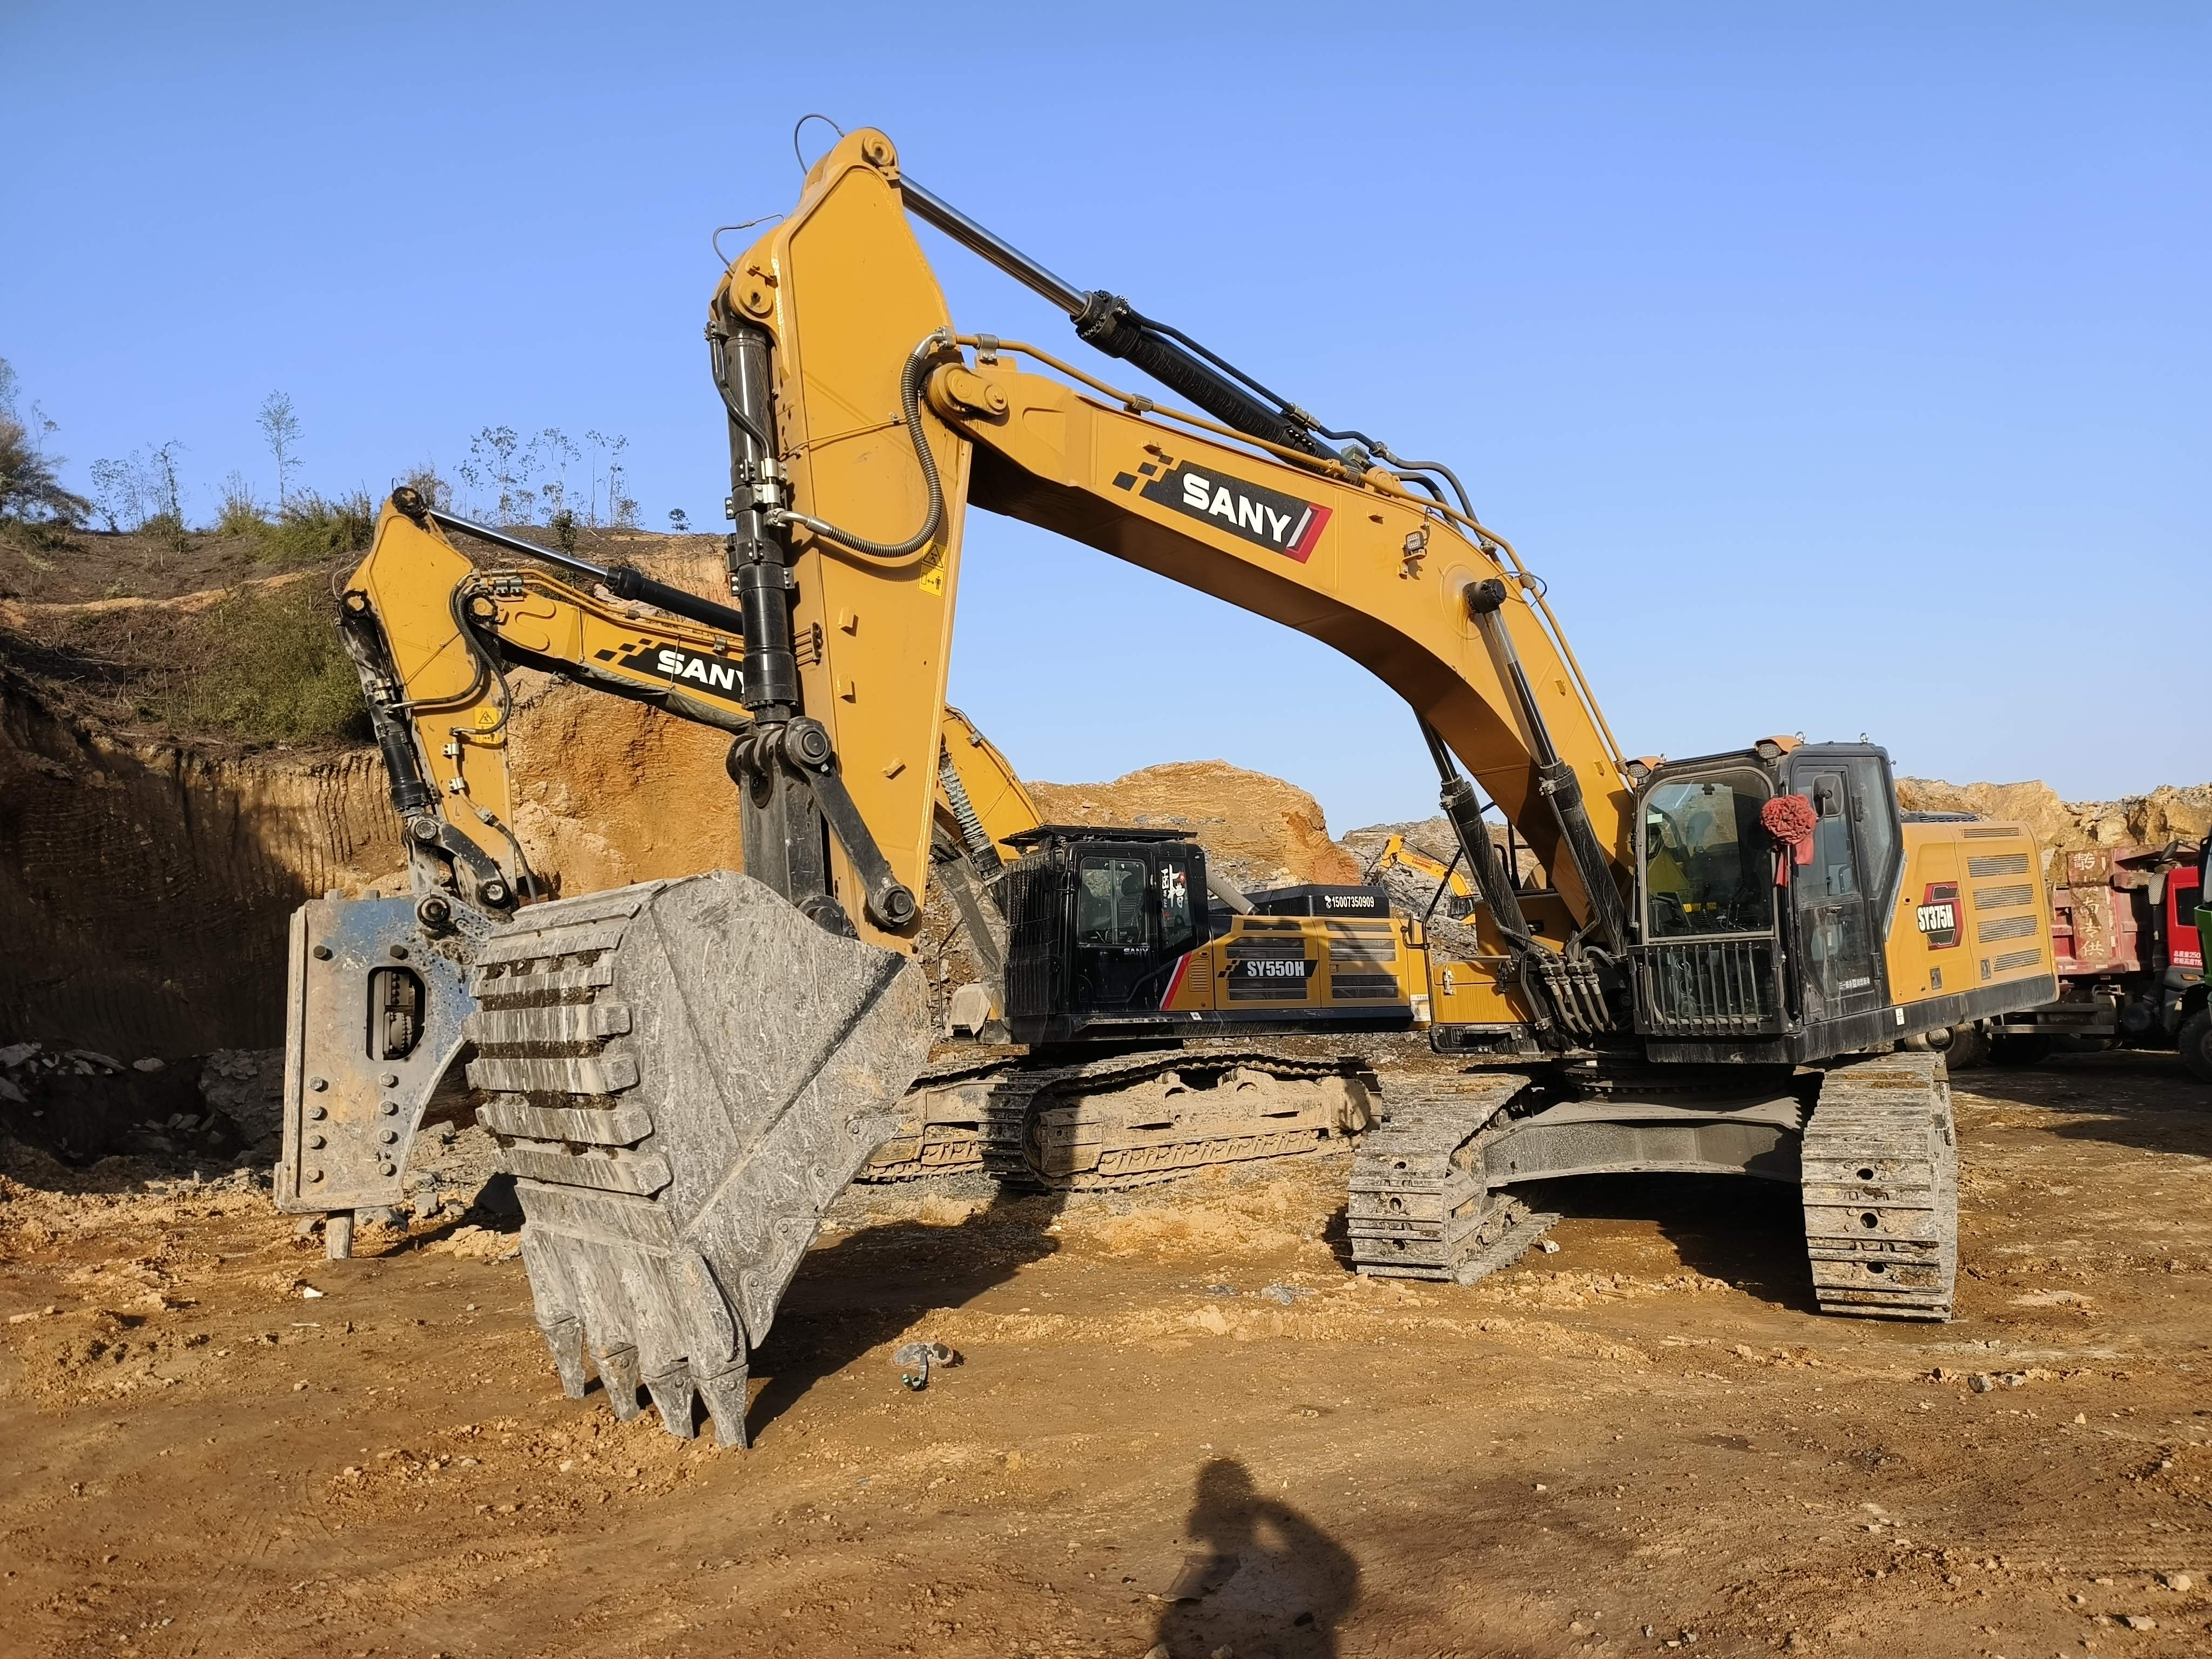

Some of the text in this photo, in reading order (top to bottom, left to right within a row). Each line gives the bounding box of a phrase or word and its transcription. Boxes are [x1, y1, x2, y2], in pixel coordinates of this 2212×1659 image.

[1183, 473, 1292, 543] SANY
[1332, 896, 1374, 908] 15007350909
[1917, 905, 1954, 931] SY375H
[1247, 961, 1305, 977] SY550H
